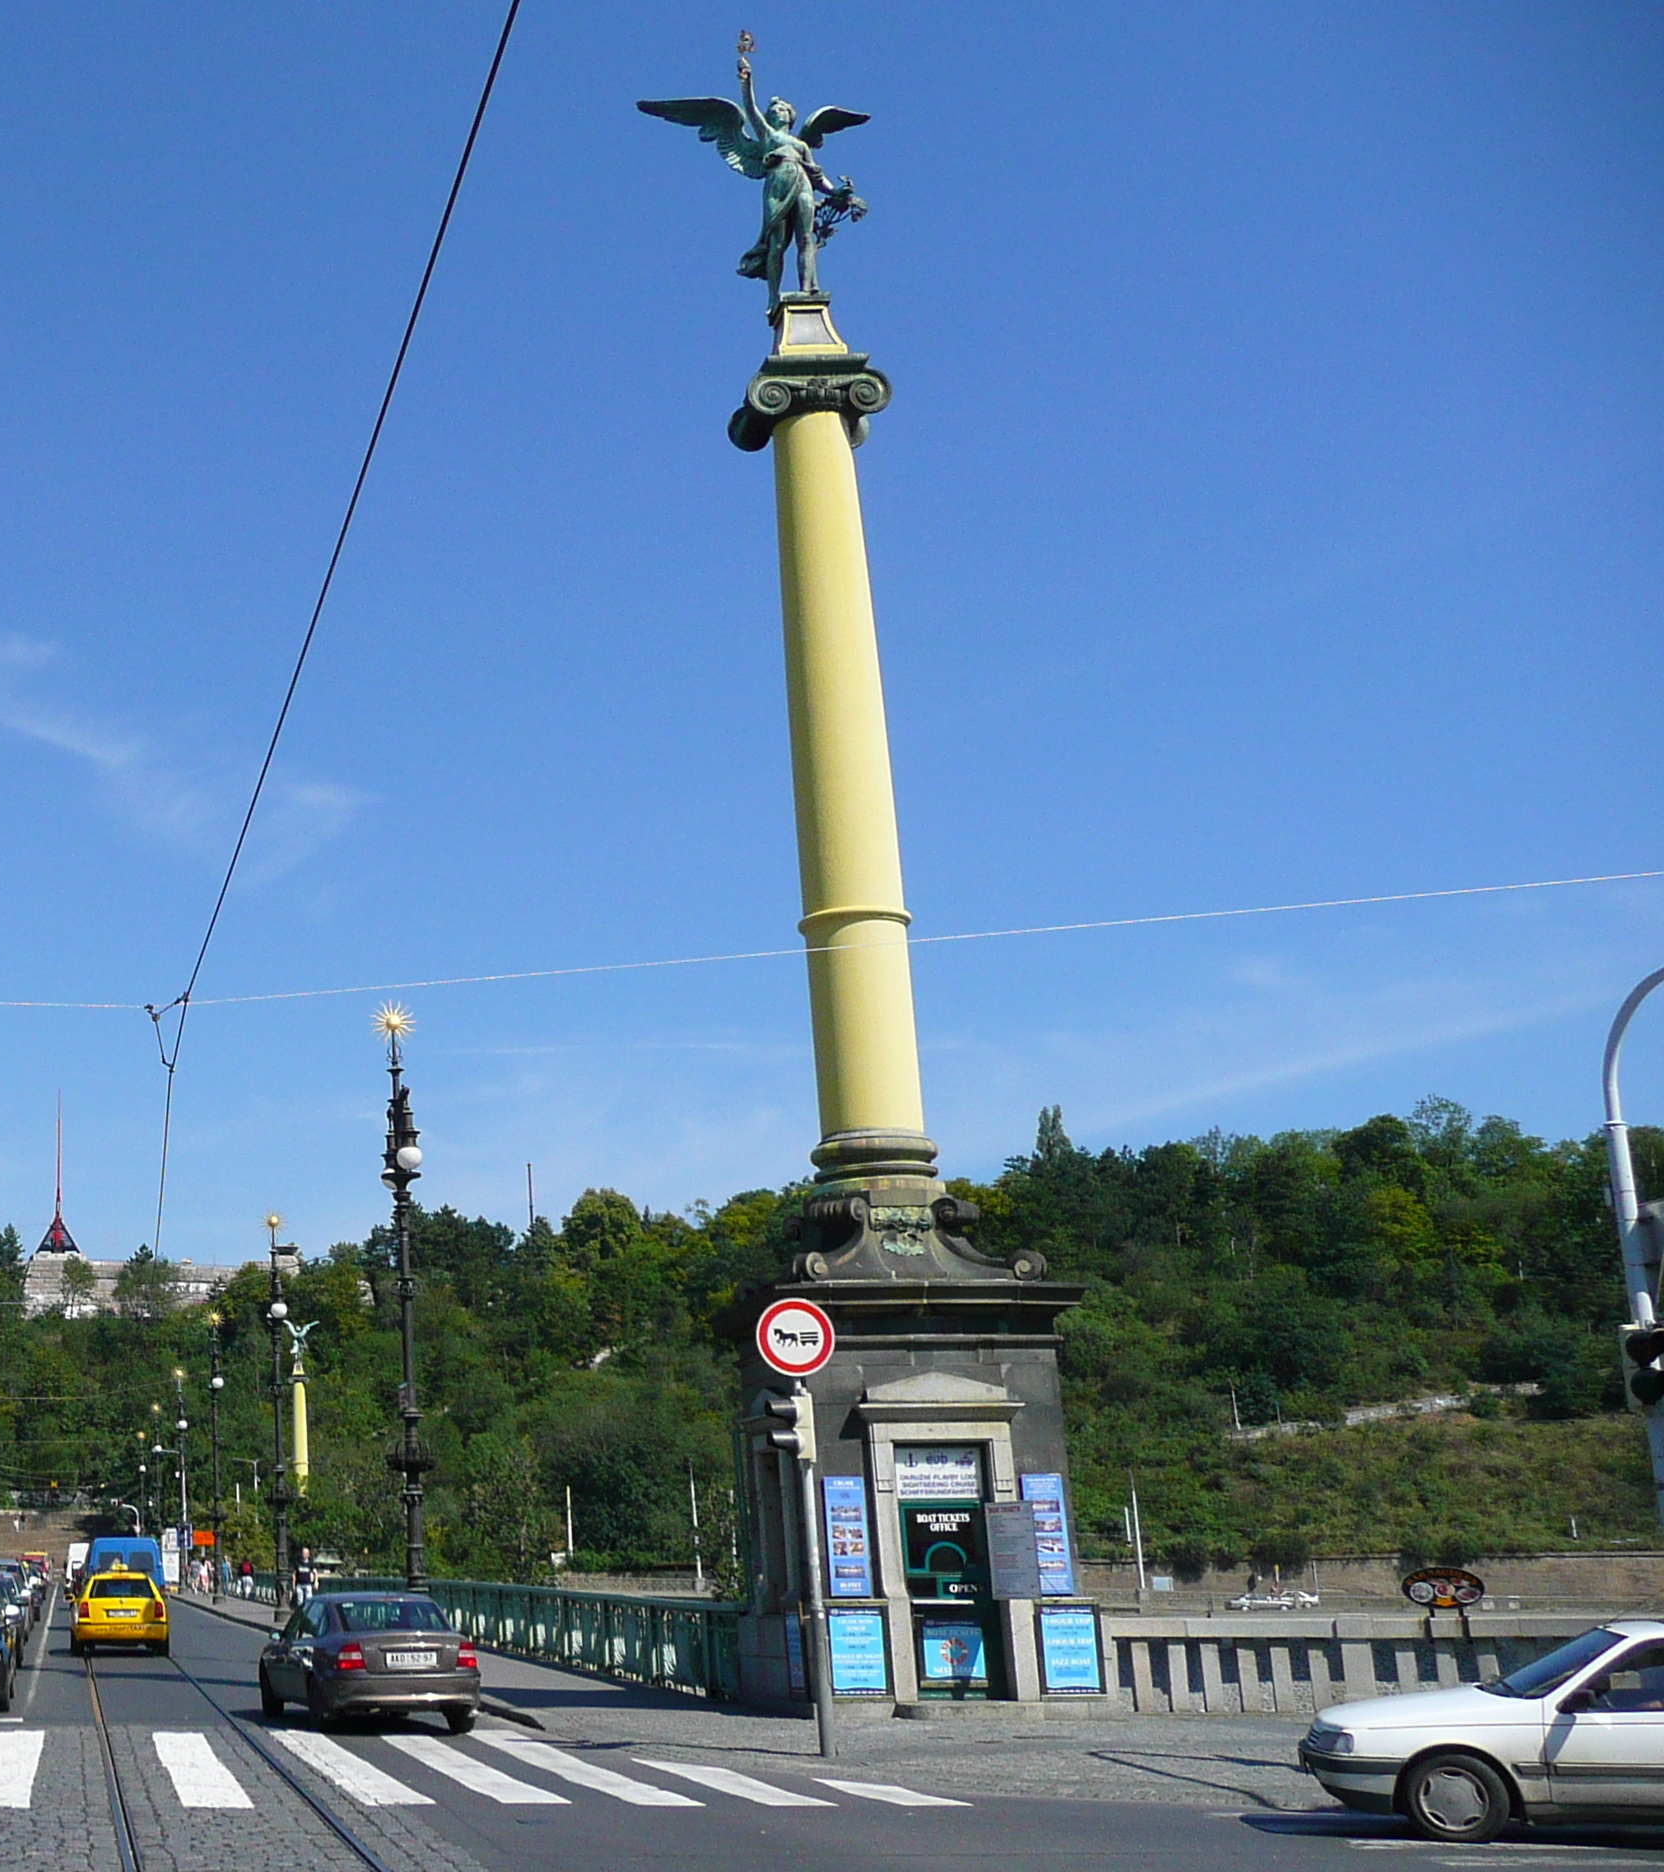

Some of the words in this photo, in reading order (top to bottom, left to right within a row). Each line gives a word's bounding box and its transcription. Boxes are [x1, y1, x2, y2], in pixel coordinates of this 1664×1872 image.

[916, 1514, 936, 1523] BOAT
[938, 1513, 970, 1522] TICKETS
[930, 1523, 958, 1532] OFFICE
[949, 1583, 978, 1593] OPEN
